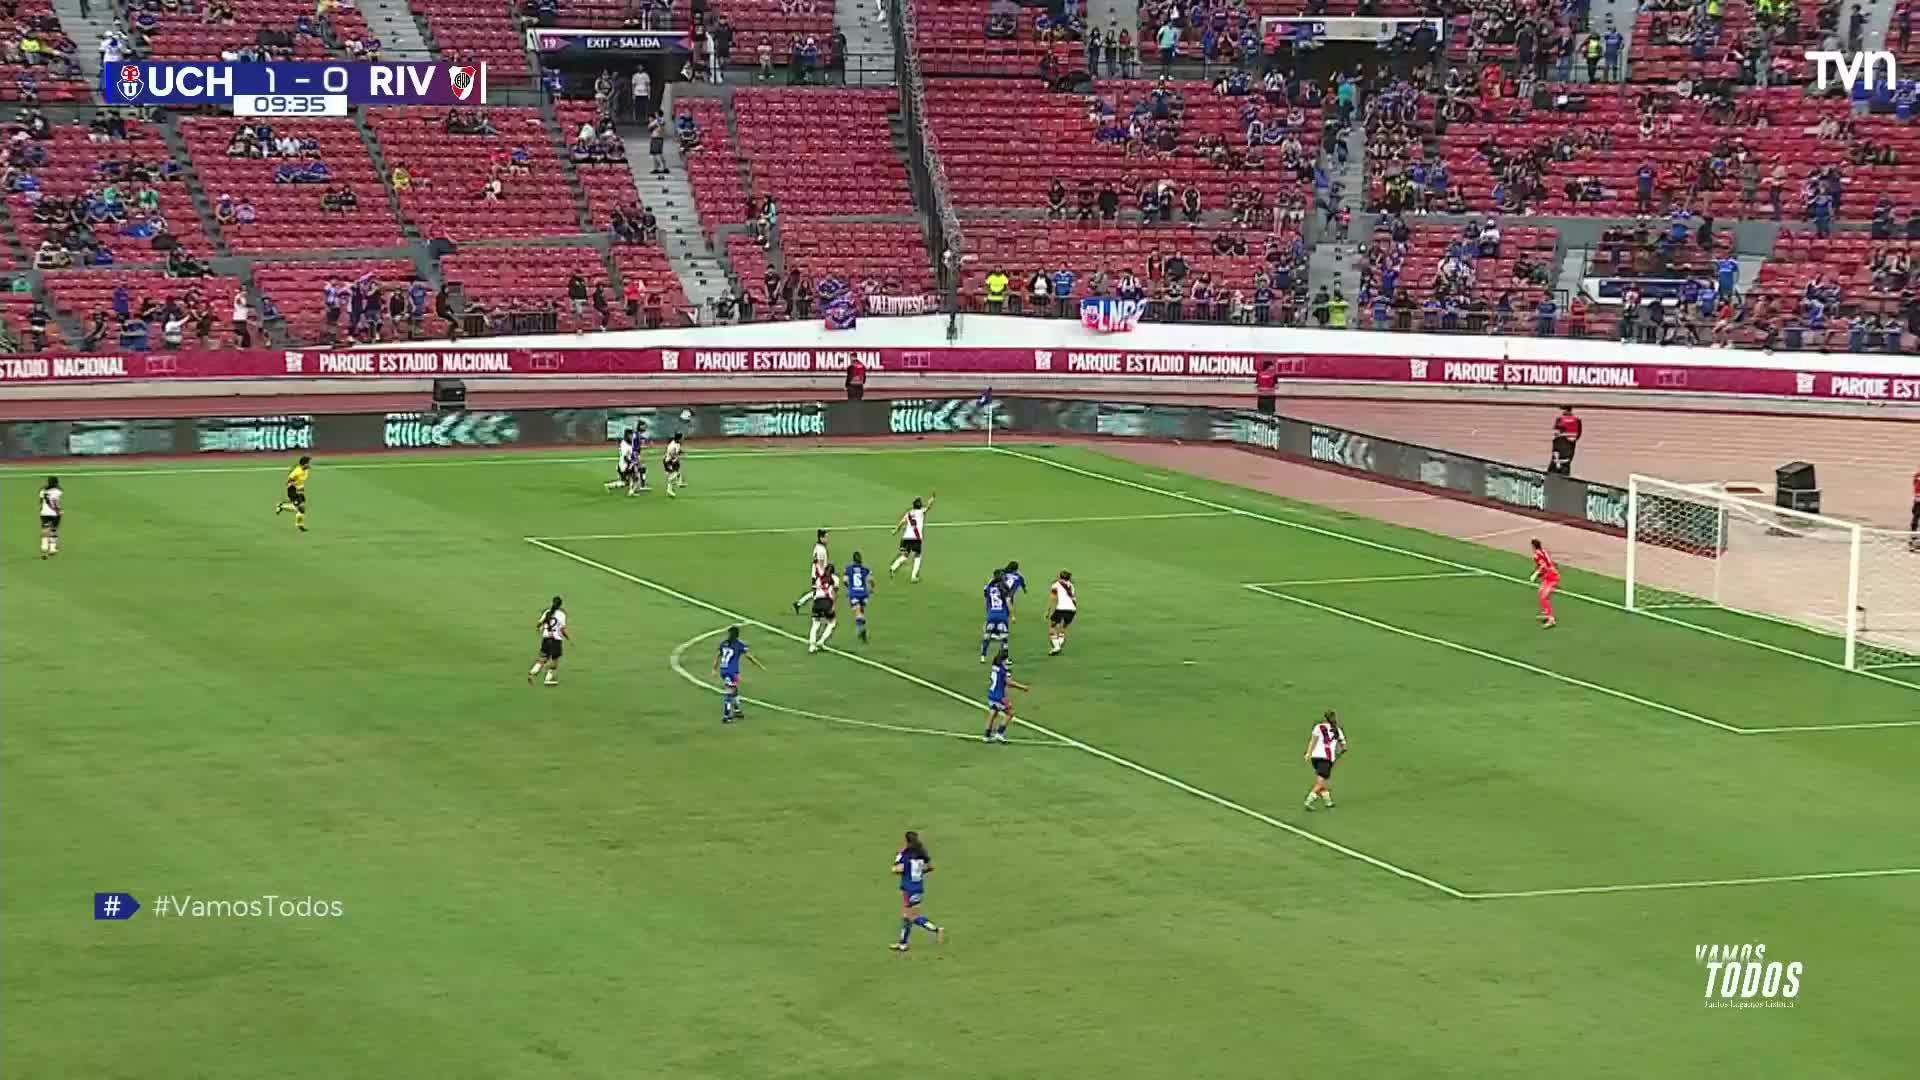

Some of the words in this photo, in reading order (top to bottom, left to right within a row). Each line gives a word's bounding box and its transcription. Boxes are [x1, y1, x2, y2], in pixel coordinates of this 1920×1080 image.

[542, 37, 557, 49] 19
[586, 37, 610, 49] EXIT
[619, 37, 661, 49] SALIDA
[53, 356, 129, 376] NACIONAL
[319, 353, 375, 373] PARQUE
[379, 352, 439, 372] ESTADIO
[442, 352, 513, 371] NACIONAL
[695, 352, 749, 374] PARQUE
[752, 351, 811, 370] ESTADIO
[815, 351, 884, 369] NACINAL
[1068, 352, 1122, 375] PARQUE
[1126, 354, 1184, 374] ESTADIO
[1188, 356, 1257, 375] NACIONAL
[1444, 361, 1499, 384] PARQUE
[1503, 364, 1563, 384] ESTADIO
[1567, 366, 1638, 387] NACIONAL
[1831, 376, 1889, 398] PARQUE
